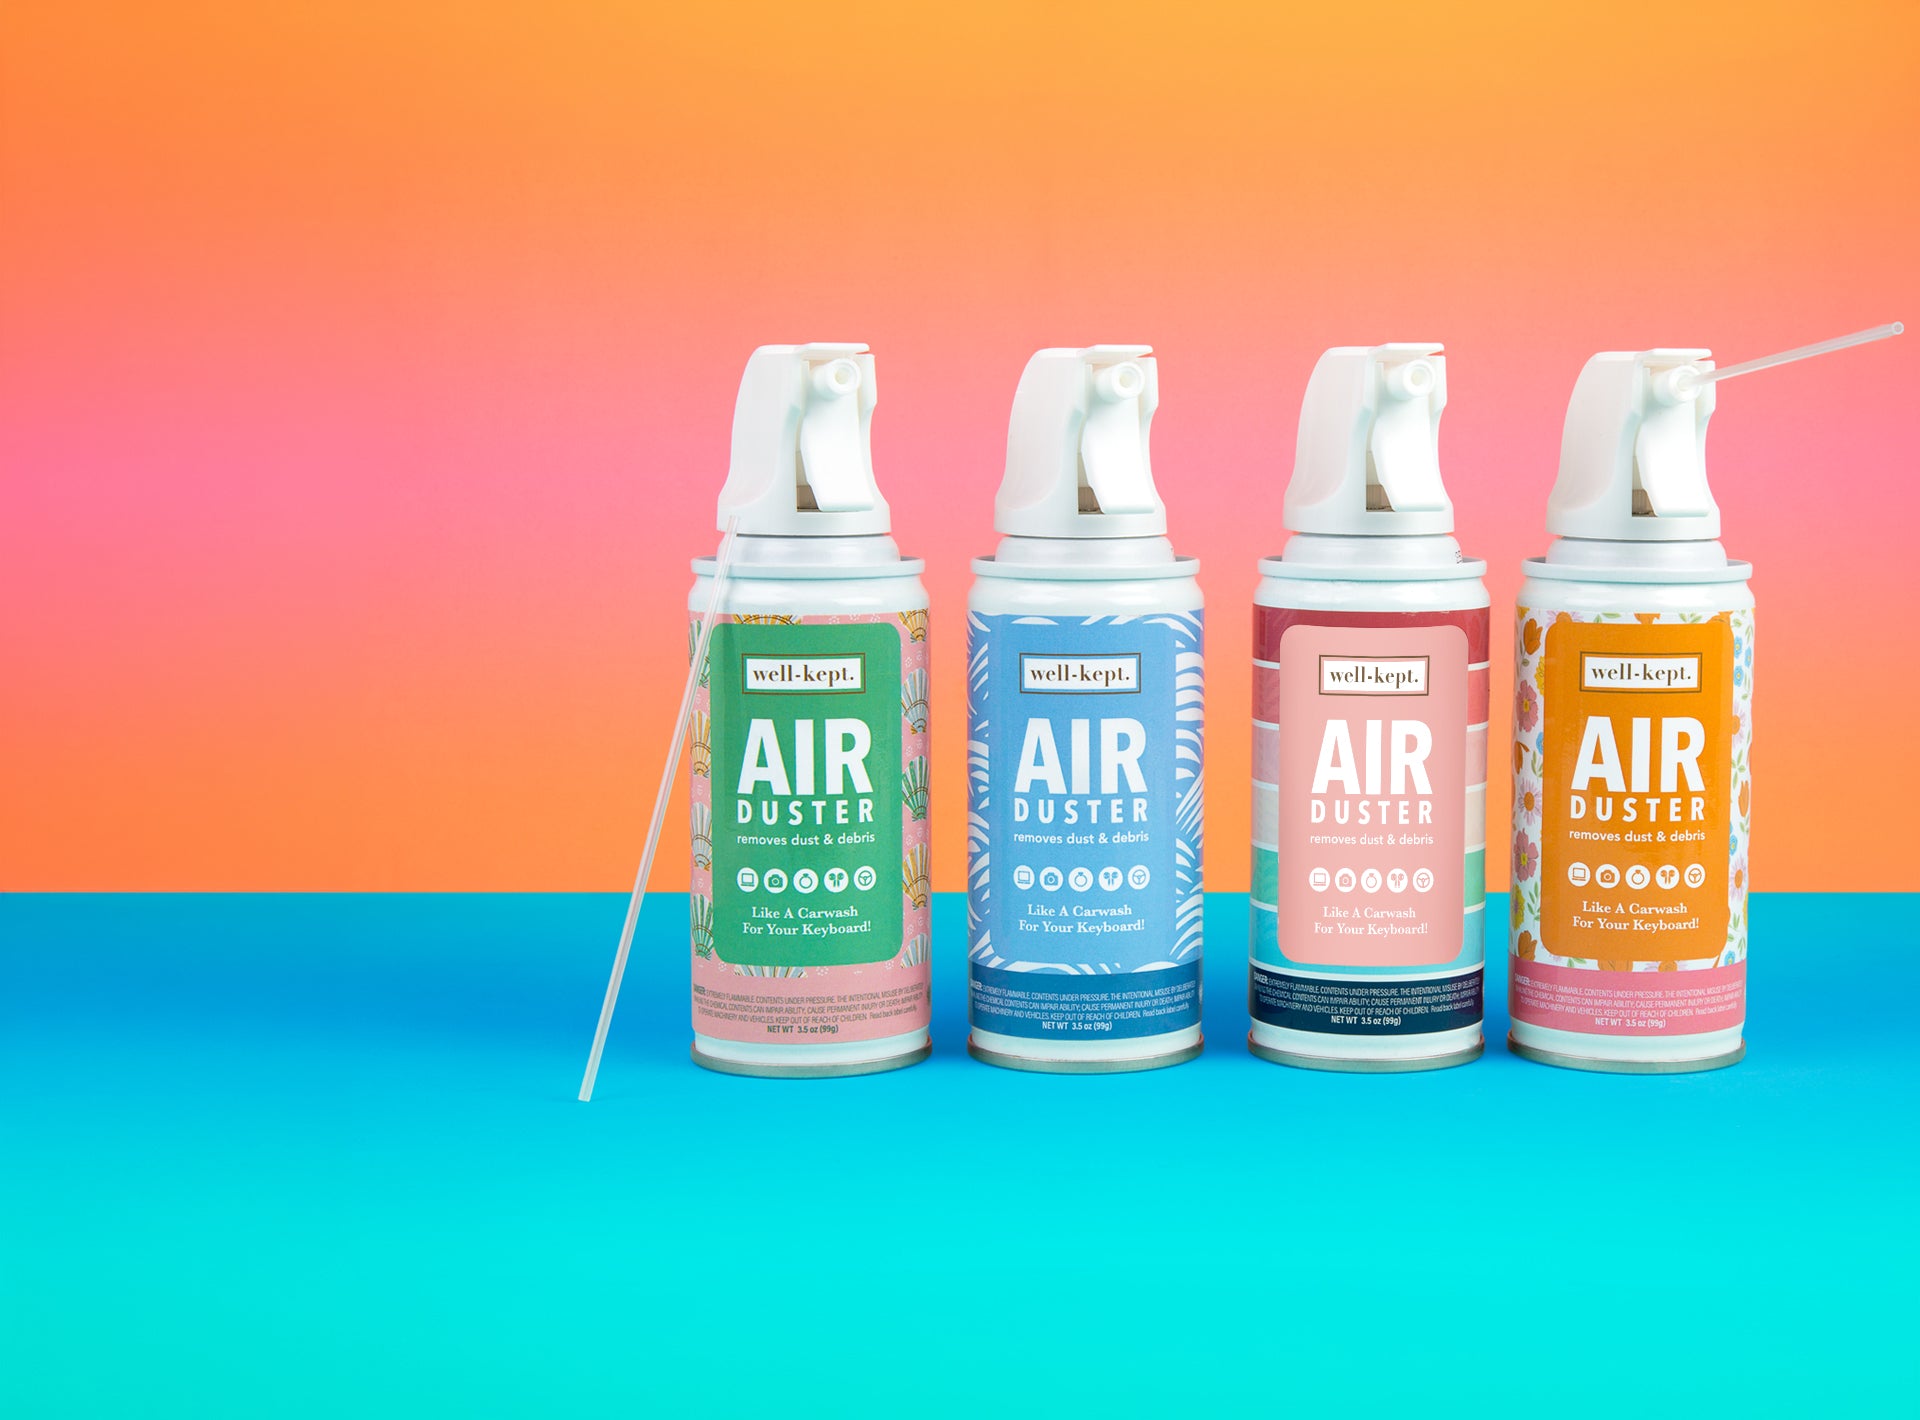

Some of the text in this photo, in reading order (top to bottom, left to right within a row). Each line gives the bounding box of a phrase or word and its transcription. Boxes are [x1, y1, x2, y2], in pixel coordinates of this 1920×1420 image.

[753, 665, 854, 687] well-kept.
[1031, 665, 1130, 686] well-kept.
[1330, 666, 1419, 689] well-kept.
[1592, 663, 1691, 685] well-kept.
[737, 718, 873, 795] AIR
[1014, 718, 1148, 794] AIR
[1311, 720, 1433, 795] AIR
[1571, 716, 1706, 793] AIR
[737, 799, 874, 825] DUSTER
[1014, 798, 1148, 824] DUSTER
[1311, 800, 1432, 824] DUSTER
[1570, 795, 1704, 822] DUSTER
[737, 832, 875, 846] removes dust & debris
[1014, 831, 1149, 844] removes dust & debris
[1310, 834, 1433, 845] removes dust & debris
[1569, 830, 1705, 842] removes dust & debris
[752, 907, 858, 919] Like A Carwash
[1027, 904, 1132, 917] Like A Carwash
[1324, 907, 1416, 919] Like A Carwash
[1582, 901, 1688, 914] Like A Carwash
[743, 921, 871, 937] For Your Keyboard!
[1019, 920, 1145, 936] For Your Keyboard!
[1314, 923, 1428, 937] For Your Keyboard!
[1573, 917, 1699, 932] For Your Keyboard!
[1094, 1022, 1112, 1031] (99g)
[1346, 1016, 1358, 1024] WT
[1383, 1016, 1401, 1026] (99g)
[1611, 1018, 1621, 1026] WT
[1626, 1019, 1636, 1027] 3.5
[1648, 1019, 1666, 1028] (99g)
[820, 1025, 838, 1033] (99g)
